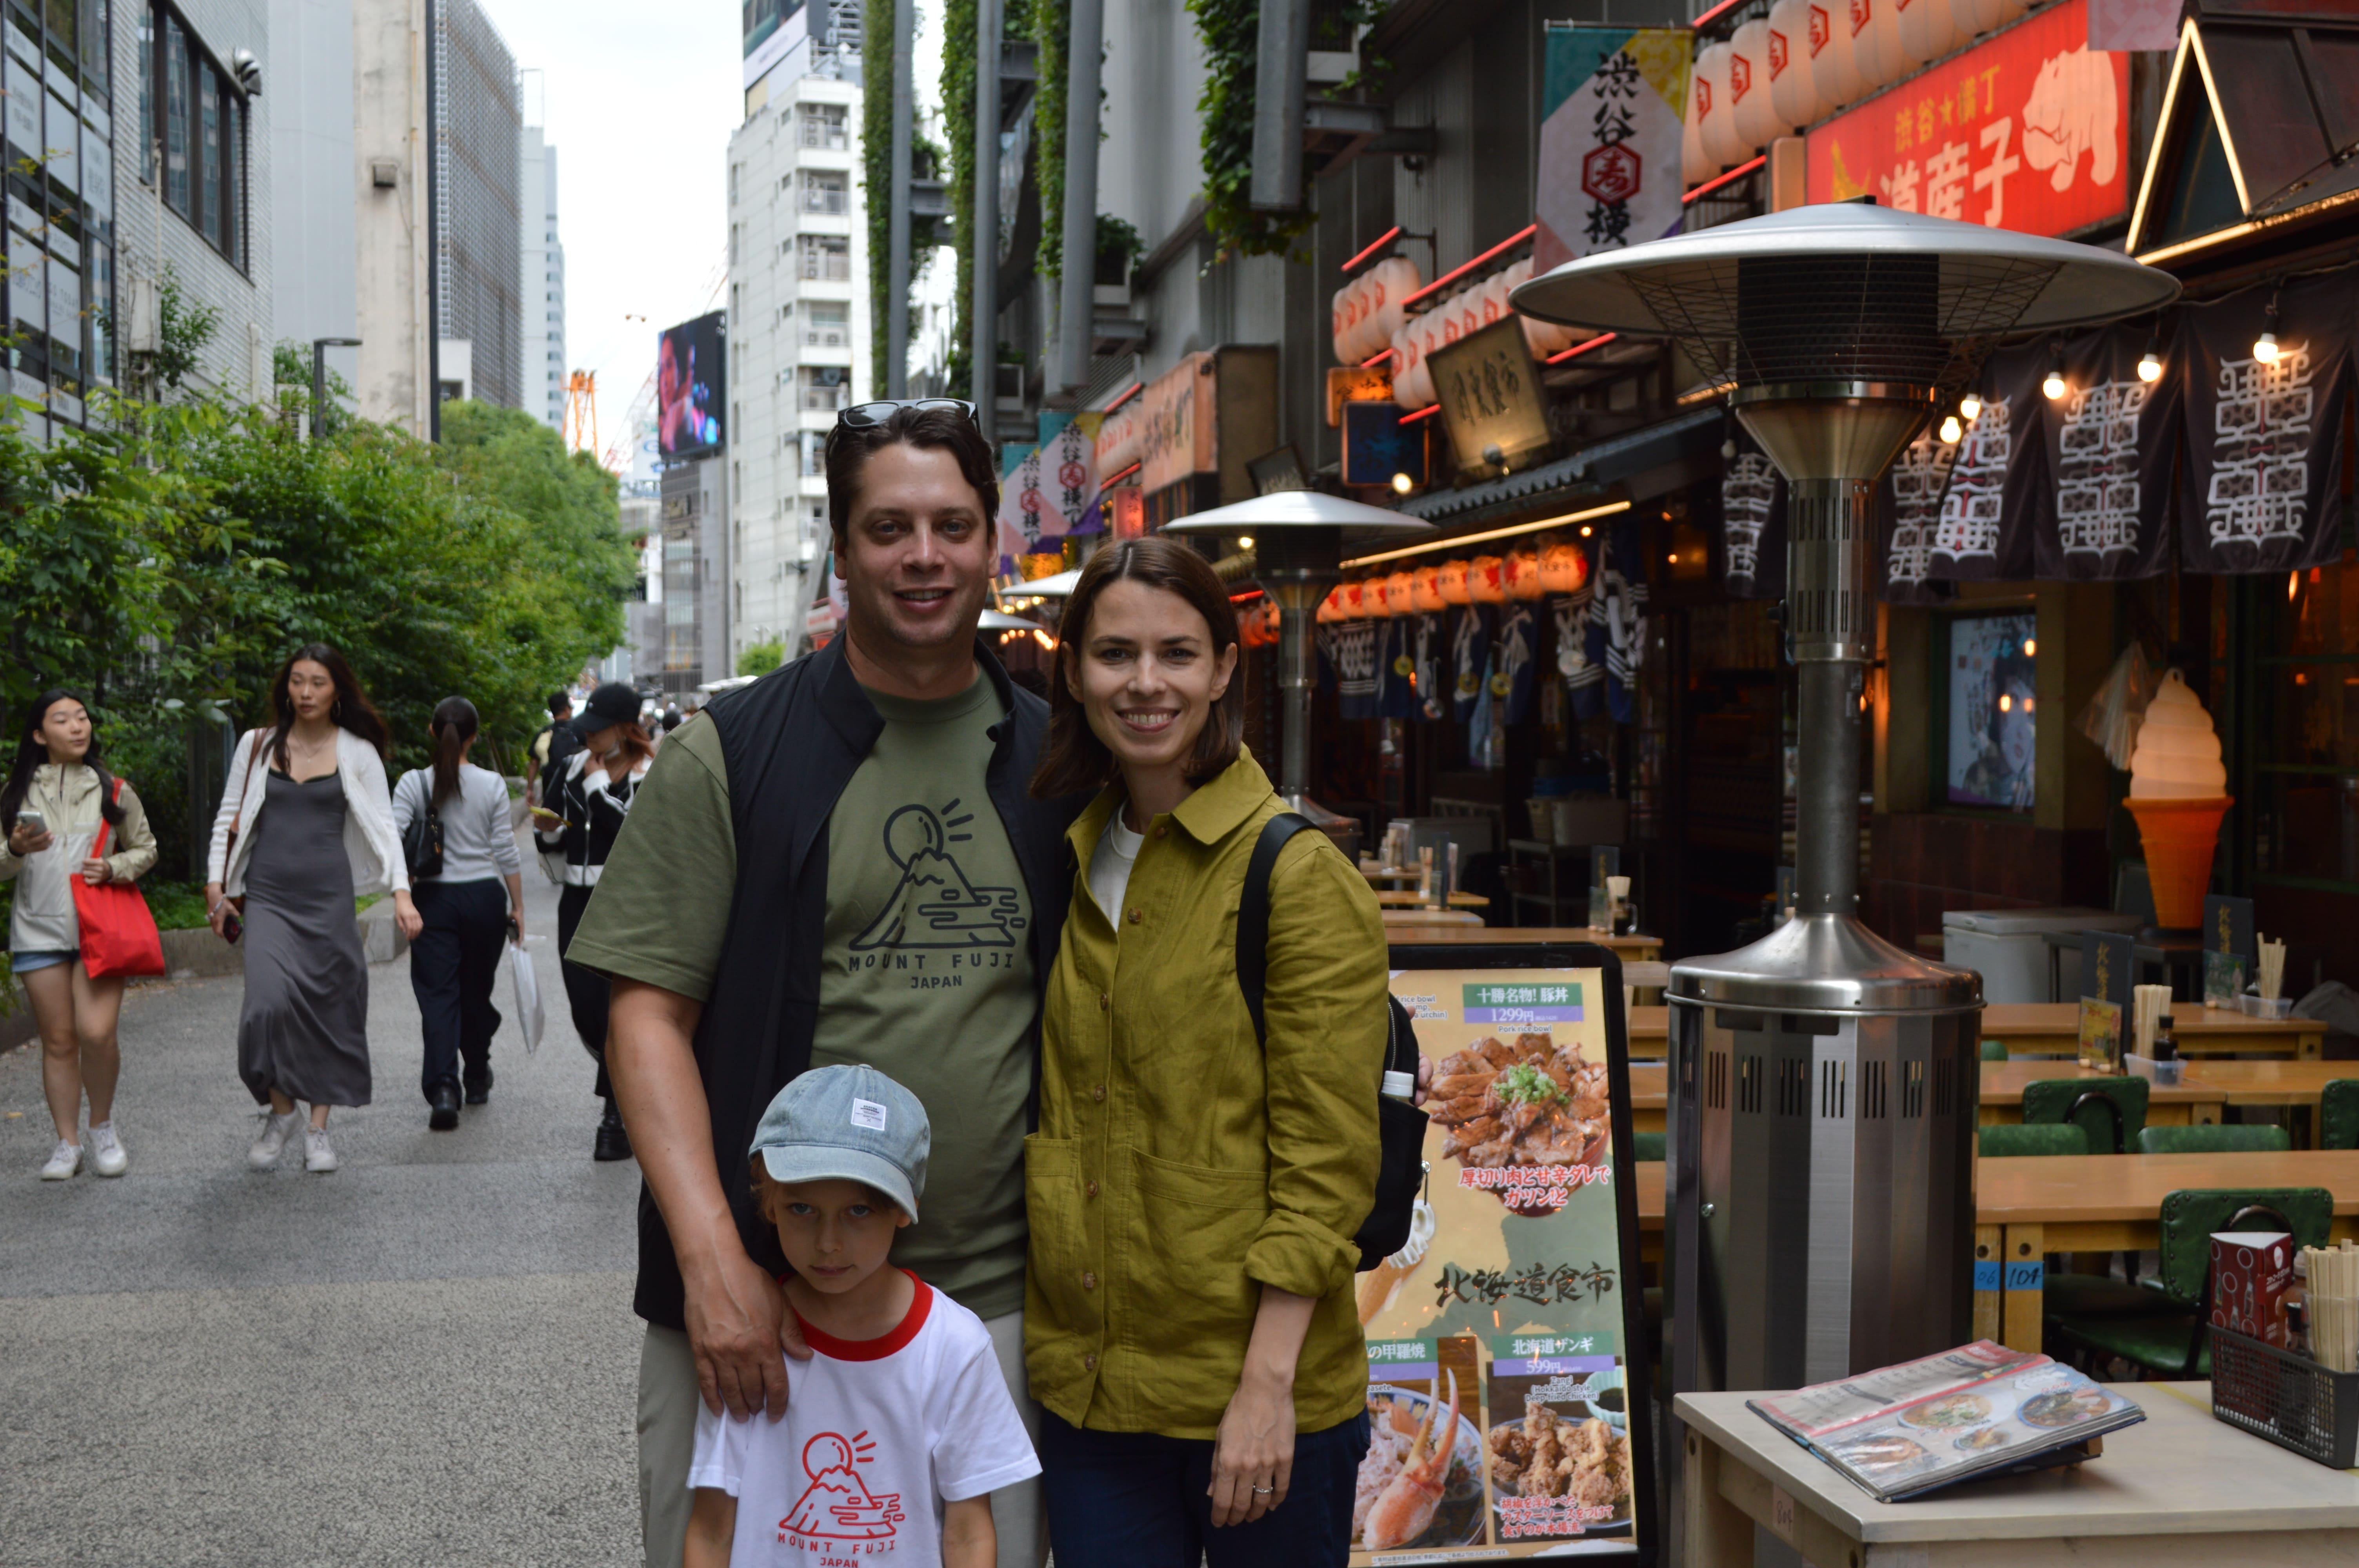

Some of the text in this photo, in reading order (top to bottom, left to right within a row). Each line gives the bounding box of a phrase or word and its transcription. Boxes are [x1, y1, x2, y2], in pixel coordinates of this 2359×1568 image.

[1880, 116, 2020, 228] 道産子
[849, 953, 1013, 972] MOUNT FUJI
[911, 975, 962, 989] JAPAN
[1490, 1008, 1534, 1022] 1299円
[1460, 1165, 1610, 1188] 厚切り肉と甘辛ダレで
[1434, 1261, 1616, 1308] 北海道食市
[1367, 1342, 1426, 1360] の甲羅焼
[1512, 1336, 1594, 1355] 北海道ザンギ
[1526, 1359, 1560, 1373] 599円
[1551, 1376, 1573, 1385] Zangi
[1531, 1385, 1590, 1394] (Hokkaido style
[1567, 1392, 1599, 1401] chicken)
[1502, 1506, 1614, 1522] ウスターソースをつけて
[778, 1532, 895, 1554] MOUNT FUJI
[820, 1557, 858, 1568] JAPAN
